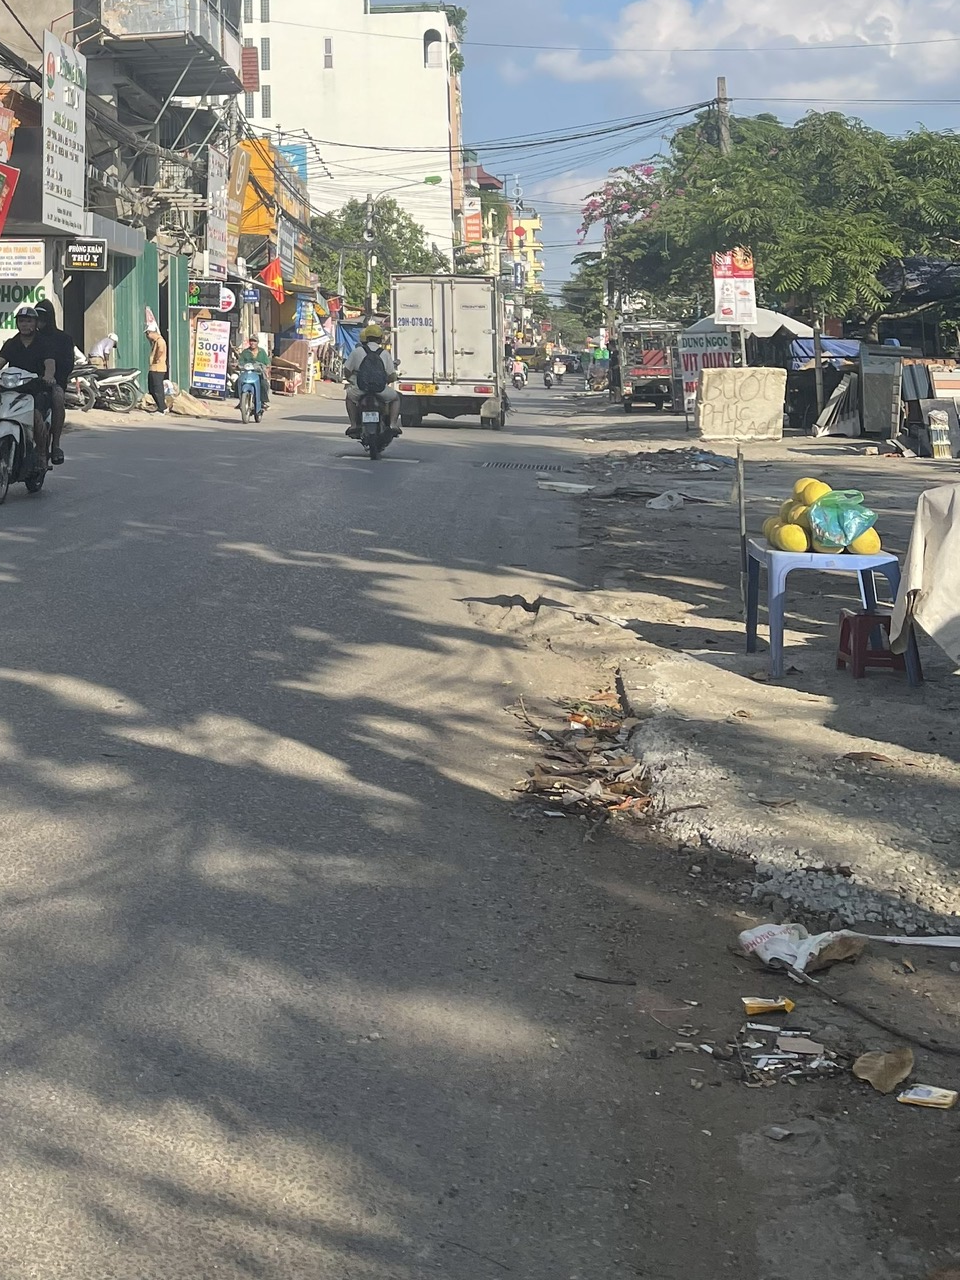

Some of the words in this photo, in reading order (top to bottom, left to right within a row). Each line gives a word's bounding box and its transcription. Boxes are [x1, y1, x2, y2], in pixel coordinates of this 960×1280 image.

[71, 253, 91, 262] THÚ
[198, 342, 227, 353] 300K
[705, 336, 728, 350] NGỌC
[213, 352, 219, 364] 1
[682, 353, 699, 376] VỊT
[702, 351, 731, 368] QUAY
